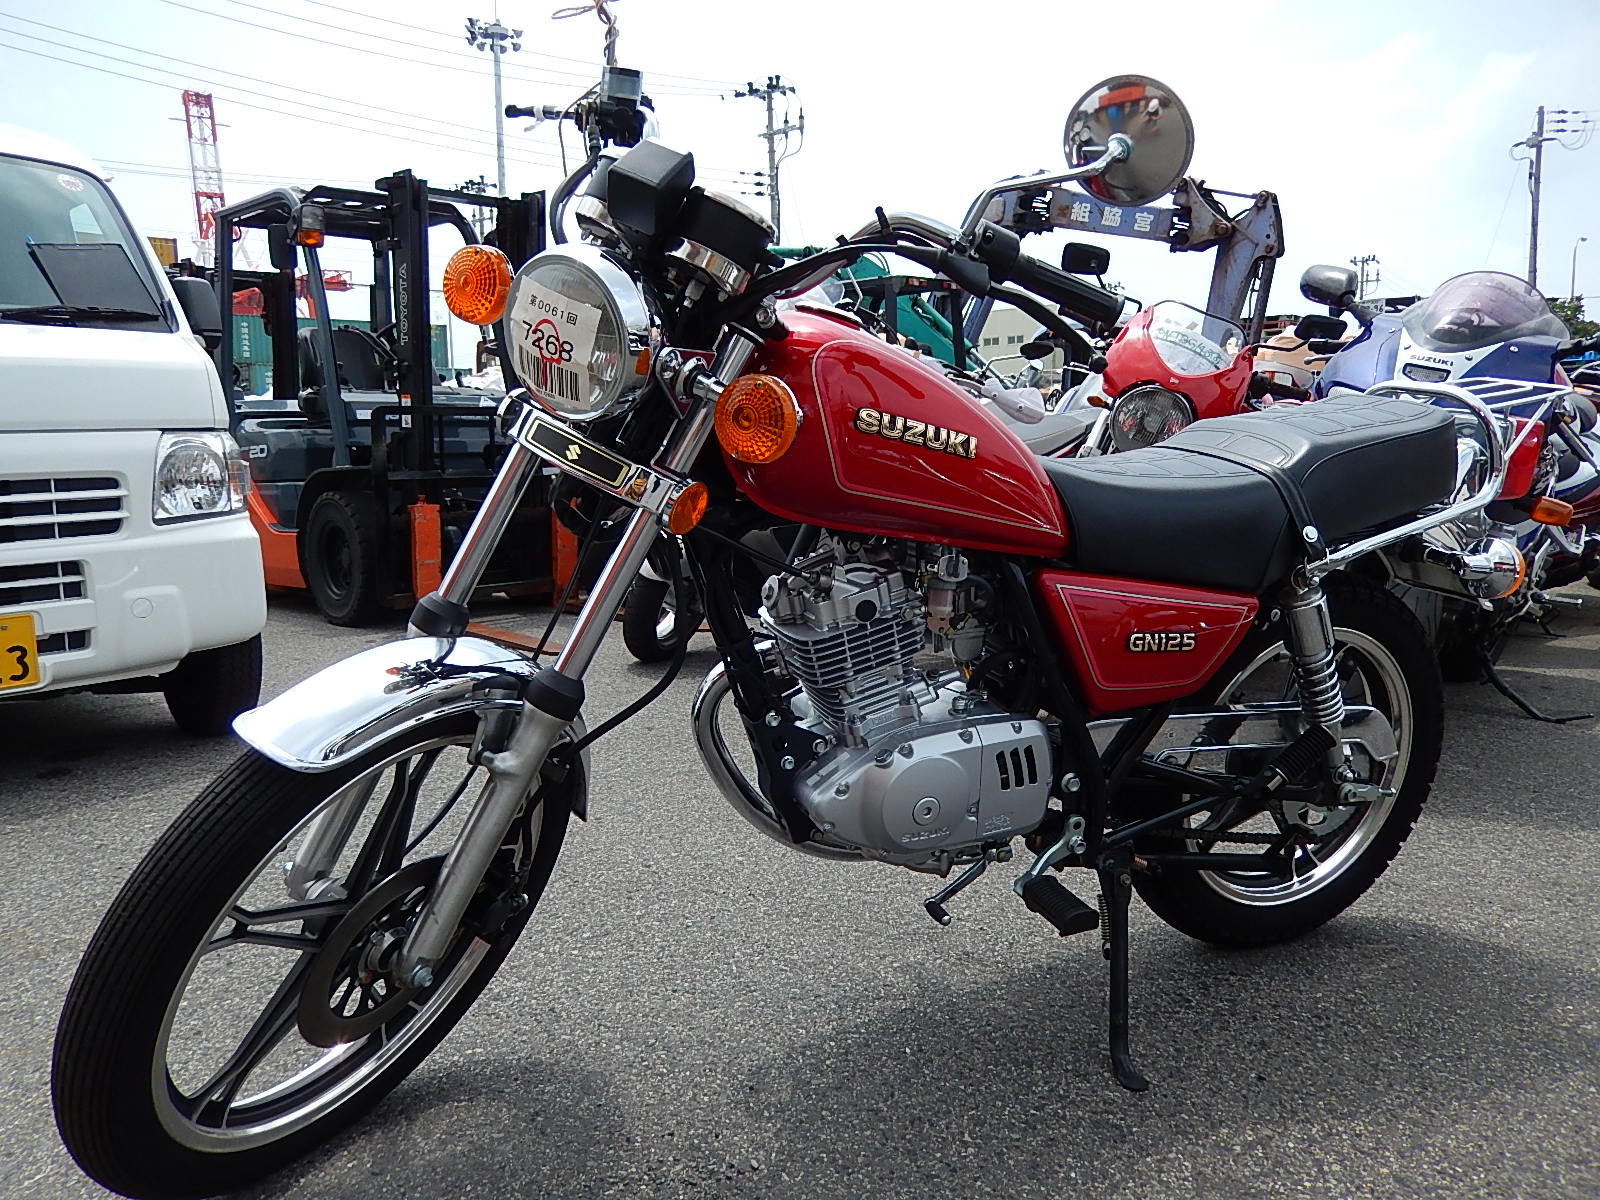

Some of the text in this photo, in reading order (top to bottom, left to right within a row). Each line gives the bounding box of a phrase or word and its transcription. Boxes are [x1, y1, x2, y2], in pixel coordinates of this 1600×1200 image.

[400, 263, 409, 346] TOYOTA
[529, 294, 578, 326] 第0061回
[522, 320, 574, 362] 7268
[1409, 354, 1454, 367] SUZUKI
[856, 407, 978, 459] SUZUKI
[1129, 633, 1196, 652] GN125
[0, 645, 30, 683] 3
